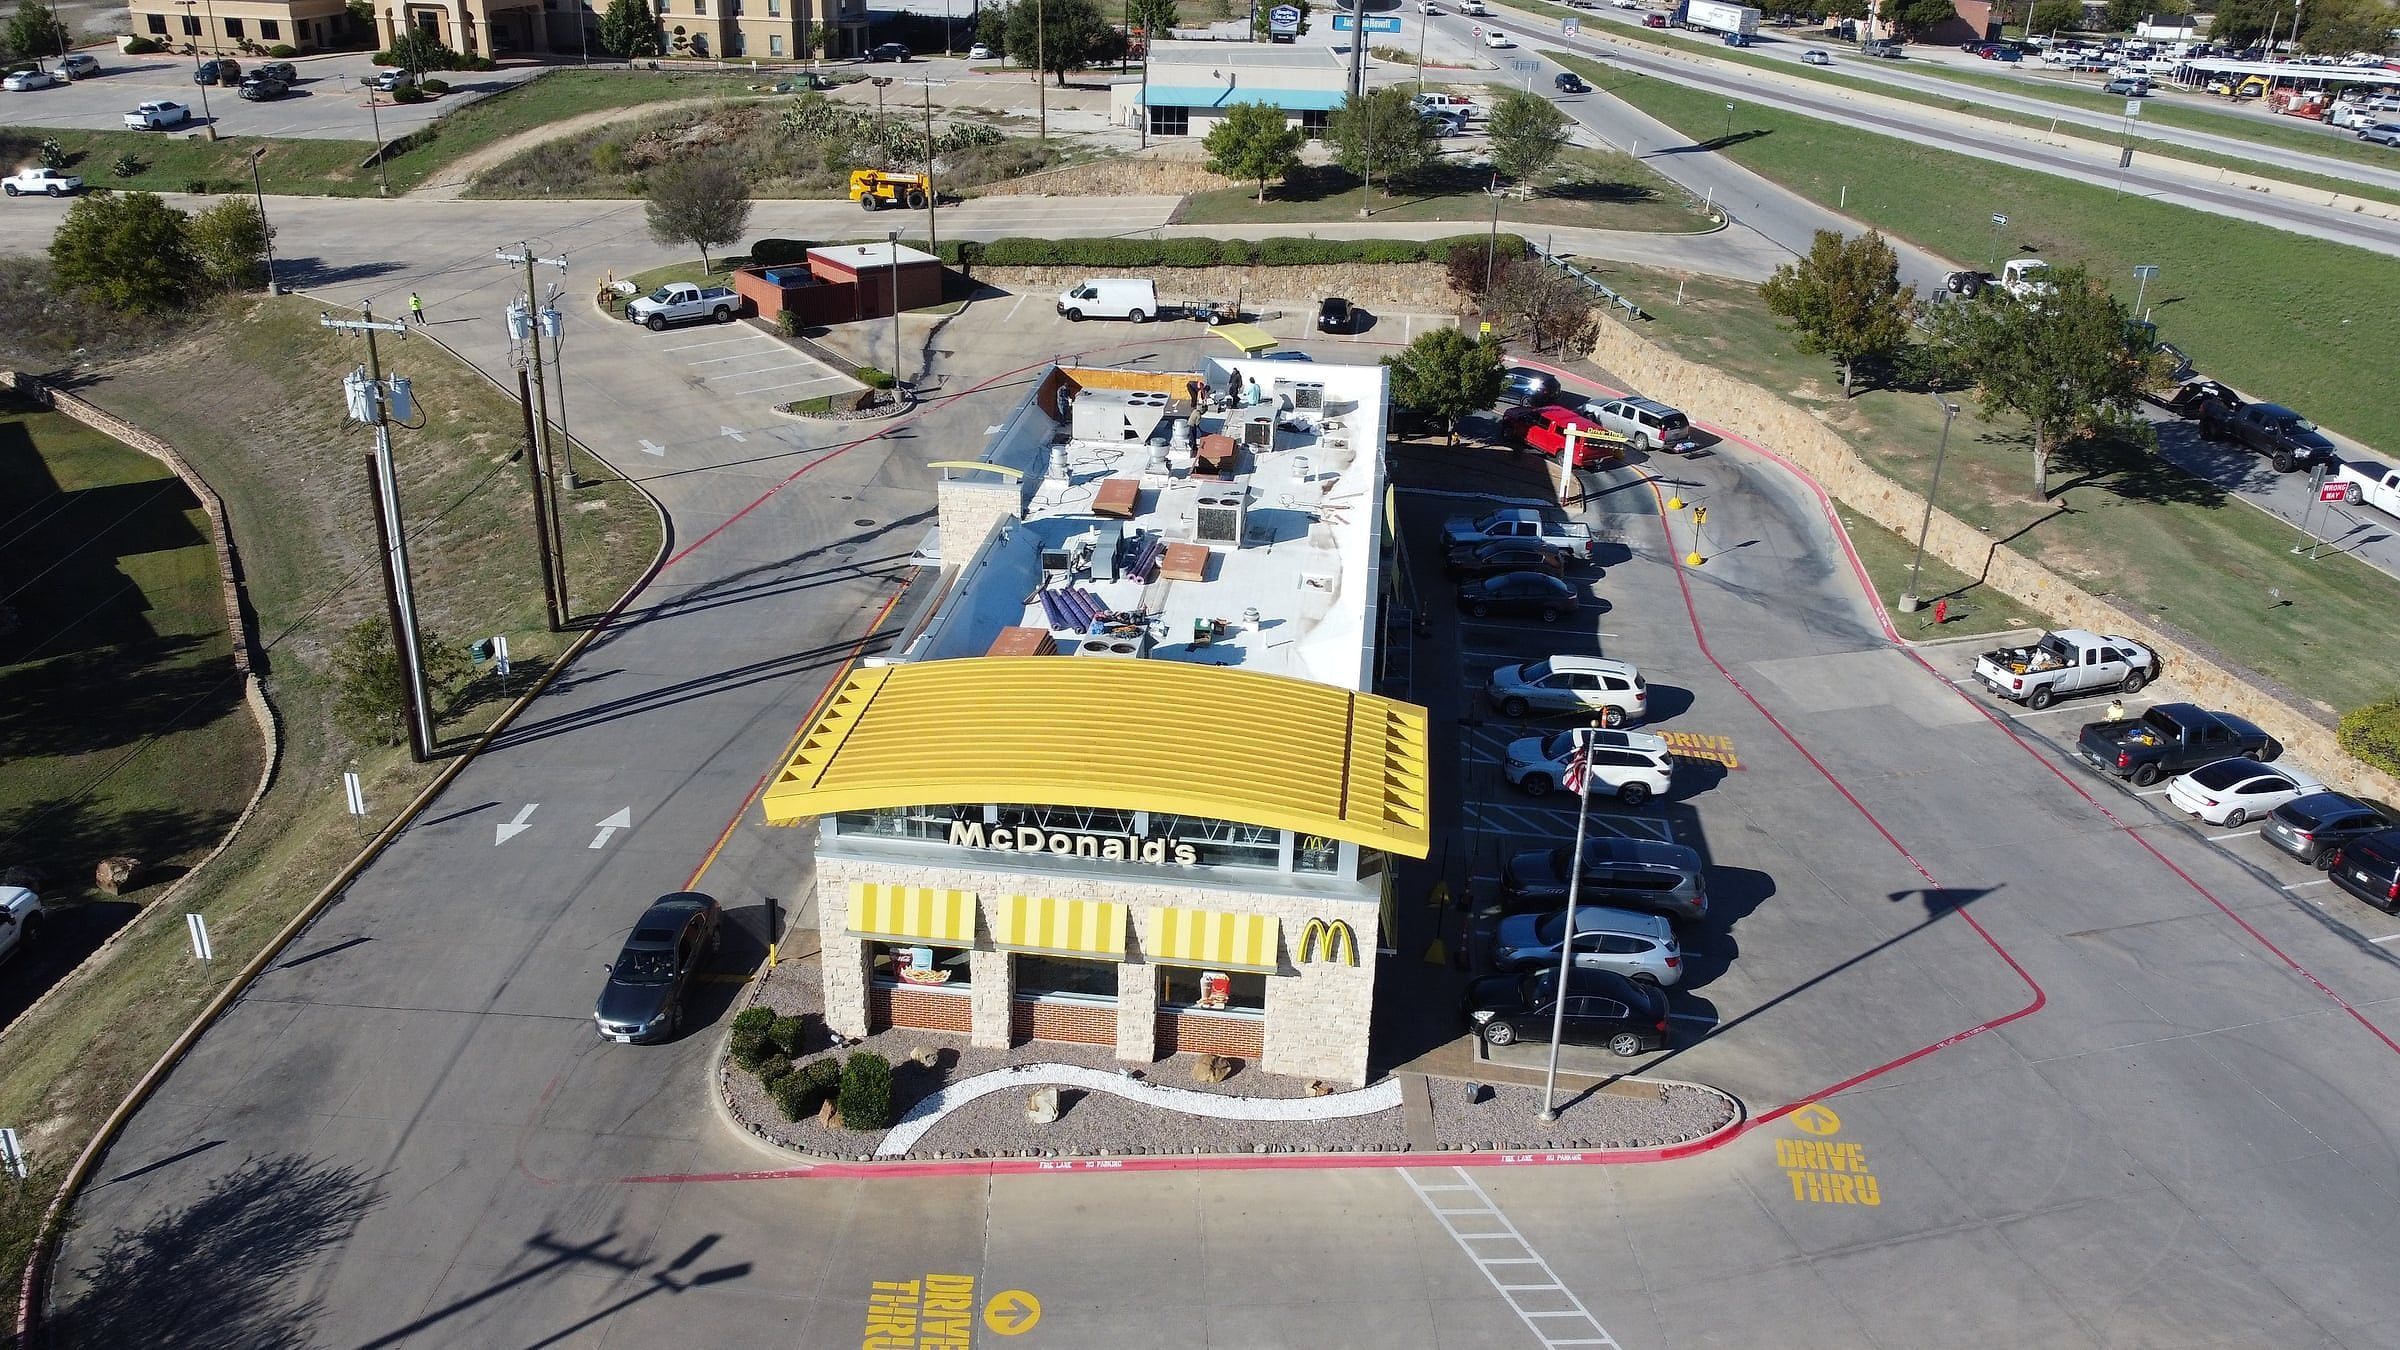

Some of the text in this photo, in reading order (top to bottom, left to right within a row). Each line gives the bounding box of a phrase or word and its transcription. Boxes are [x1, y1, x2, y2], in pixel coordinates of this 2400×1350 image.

[2326, 491, 2340, 499] WAY
[1656, 731, 1735, 751] DRIVE
[949, 819, 1197, 867] McDonald's
[1776, 1139, 1868, 1173] DRIVE
[1787, 1170, 1880, 1205] THRU
[862, 1280, 920, 1350] THRU
[920, 1274, 974, 1350] DRIVE
